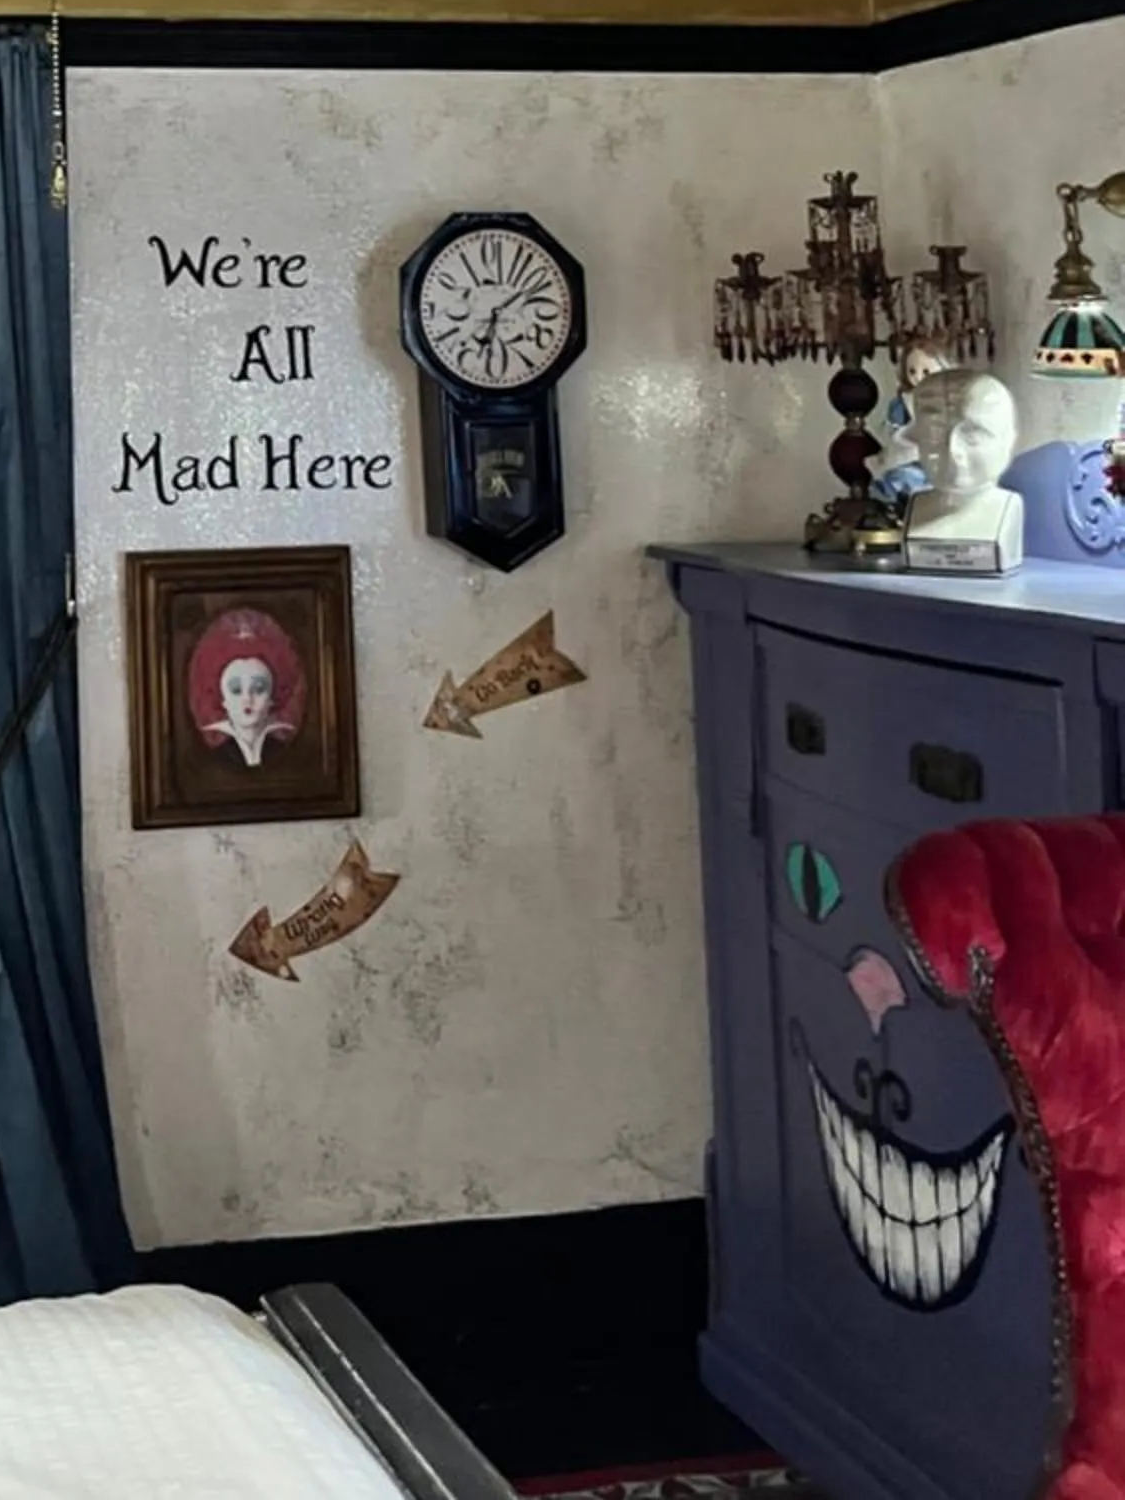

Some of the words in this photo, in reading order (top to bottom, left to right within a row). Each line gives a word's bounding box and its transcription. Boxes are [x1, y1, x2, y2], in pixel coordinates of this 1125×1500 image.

[148, 235, 307, 288] We're
[230, 324, 315, 385] All
[112, 432, 239, 506] Mad
[259, 434, 392, 490] Here
